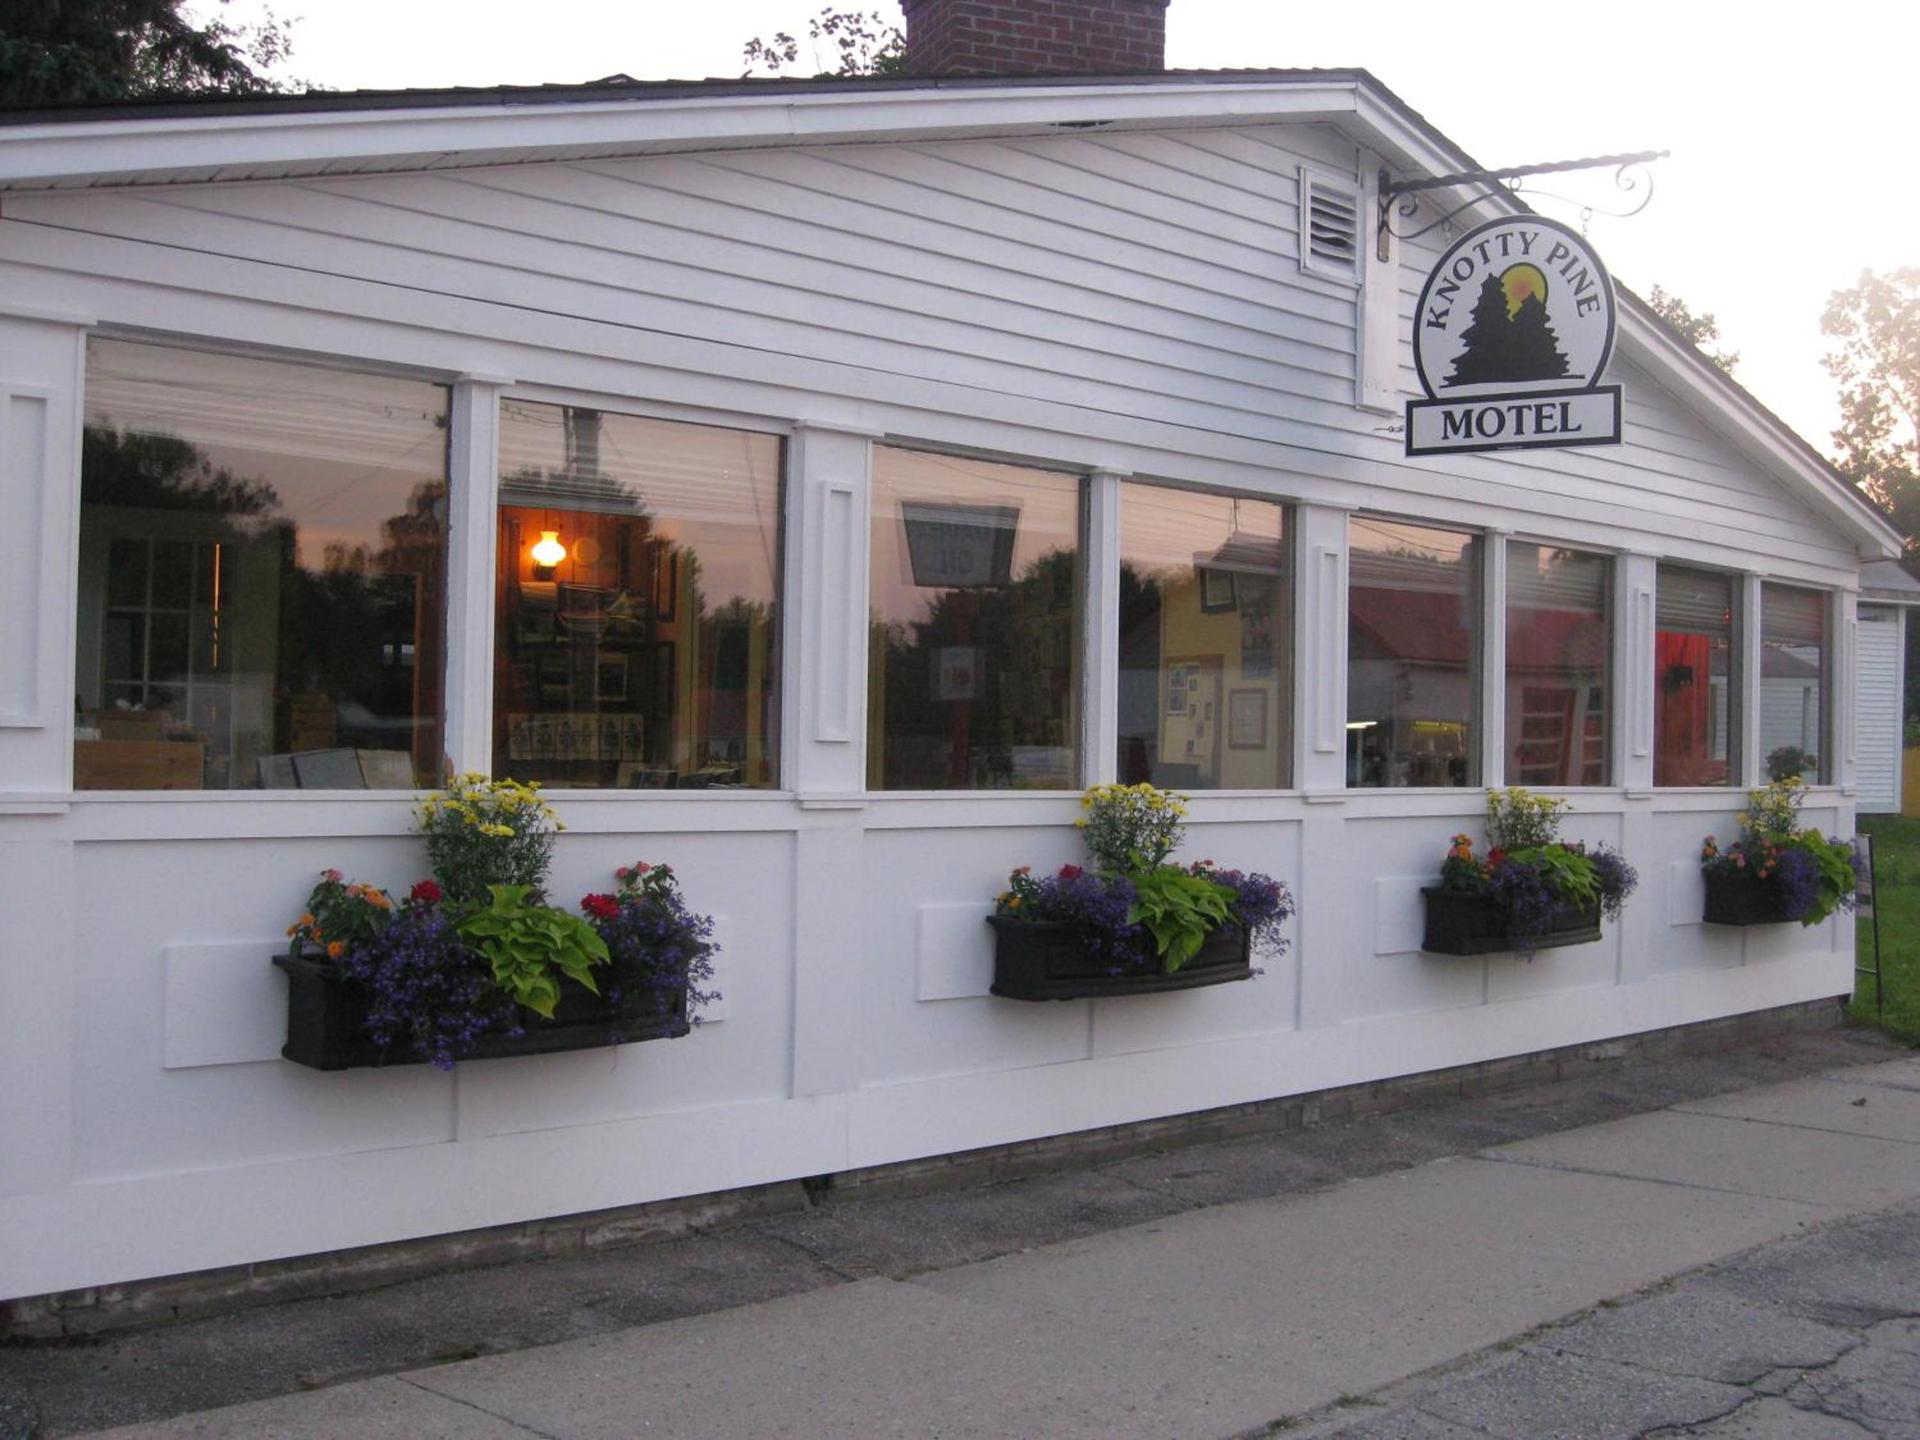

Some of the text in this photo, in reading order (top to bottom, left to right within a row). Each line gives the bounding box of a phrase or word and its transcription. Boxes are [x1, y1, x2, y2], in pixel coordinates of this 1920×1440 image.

[1426, 231, 1600, 330] KNOTTY PINE
[1441, 402, 1582, 440] MOTEL
